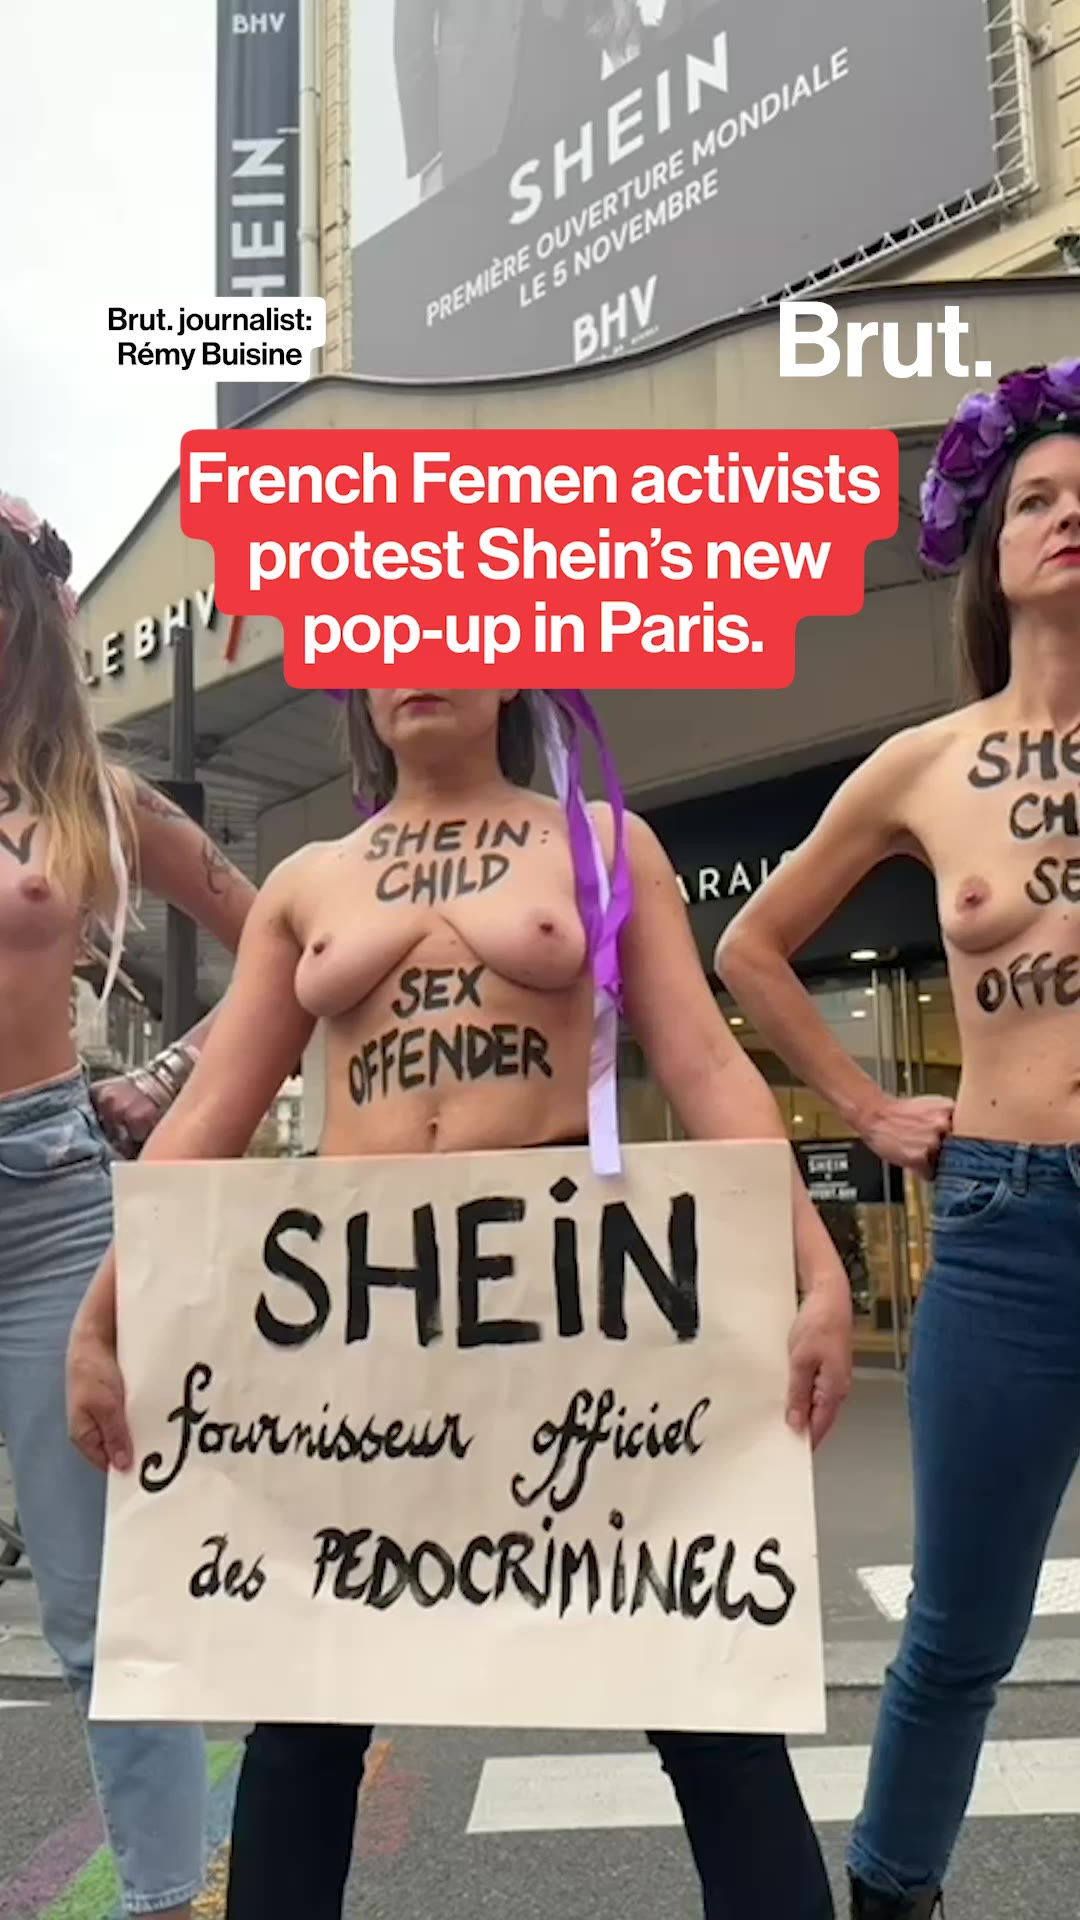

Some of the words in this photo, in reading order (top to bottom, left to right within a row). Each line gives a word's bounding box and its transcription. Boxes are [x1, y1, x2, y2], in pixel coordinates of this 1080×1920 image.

[232, 12, 286, 33] BHV
[507, 31, 729, 226] SHEIN
[231, 137, 287, 297] HEIN
[425, 244, 531, 328] PREMIÈRE
[536, 149, 684, 260] OUVERTURE
[692, 46, 849, 168] MONDIALE
[519, 272, 547, 308] LE
[553, 258, 568, 288] 5
[573, 168, 719, 276] NOVEMBRE
[573, 273, 658, 365] BHV
[79, 630, 125, 687] LE
[134, 583, 219, 661] BHV
[375, 853, 510, 907] CHILD
[675, 849, 793, 905] RAI
[391, 964, 485, 1019] SEX
[349, 1023, 554, 1107] OFFENDER
[139, 1362, 474, 1494] fournisseur
[511, 1388, 712, 1512] officiel
[189, 1533, 268, 1602] des
